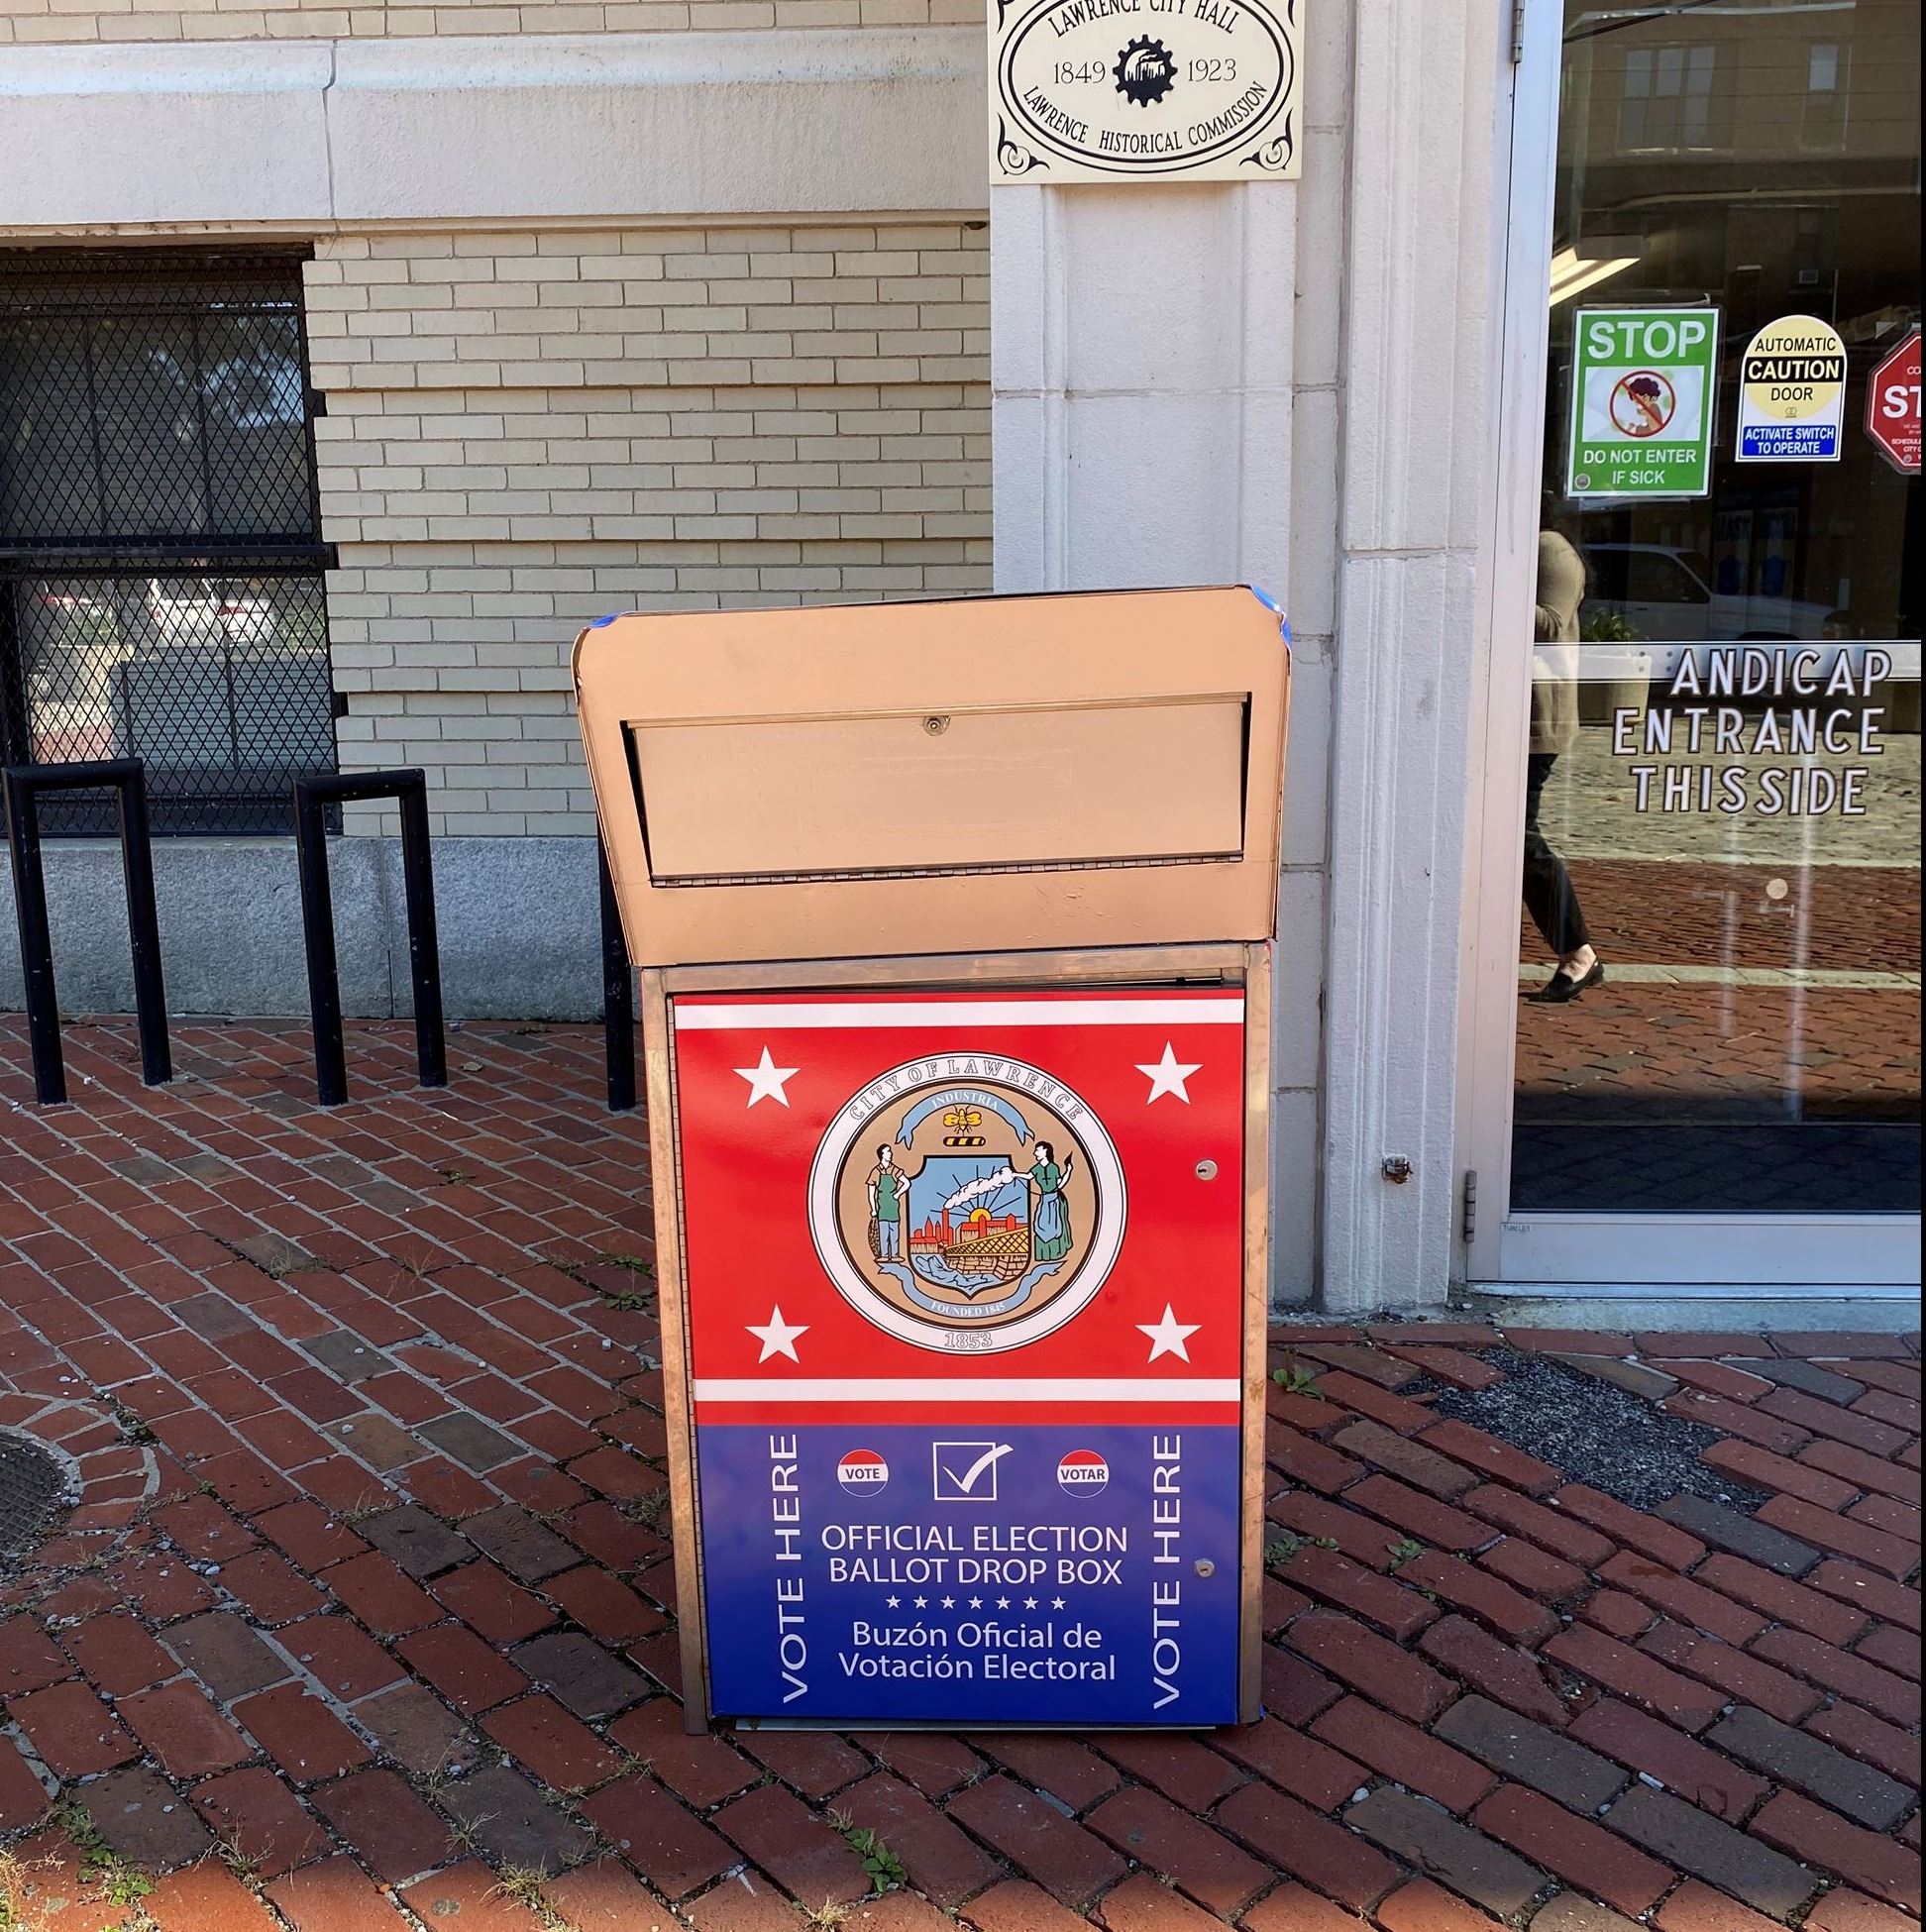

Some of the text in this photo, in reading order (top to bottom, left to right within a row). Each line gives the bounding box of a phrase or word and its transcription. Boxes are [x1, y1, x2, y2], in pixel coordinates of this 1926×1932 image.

[1194, 0, 1239, 34] HALL
[1054, 58, 1236, 84] 1849 1923
[1023, 80, 1268, 154] LAWRENCE HISTORICAL COMMISSION
[1587, 320, 1706, 360] STOP
[1755, 337, 1836, 352] AUTOMATIC
[1748, 360, 1840, 379] CAUTION
[1770, 387, 1813, 401] DOOR
[1745, 427, 1835, 441] ACTIVATE SWITCH
[1583, 449, 1696, 464] DO NOT ENTER
[1757, 441, 1820, 455] TO OPERATE
[1612, 470, 1665, 484] IF SICK
[1669, 648, 1893, 698] ANDICAP
[1612, 706, 1886, 756] ENTRANCE
[849, 1058, 1083, 1121] CITY OF LAWRENCE
[931, 1091, 999, 1110] INDUSTRIA
[931, 1301, 982, 1316] FOUNDED
[944, 1332, 993, 1348] 1853
[845, 1467, 881, 1480] VOTE
[1060, 1467, 1106, 1481] VOTAR
[820, 1525, 1127, 1553] OFFICIAL ELECTION
[770, 1434, 808, 1704] VOTE HERE
[829, 1557, 1123, 1585] BALLOT DROP BOX
[1153, 1435, 1180, 1710] VOTE HERE
[853, 1621, 1103, 1649] Buzón Oficial de
[838, 1653, 1116, 1680] Votación Electoral
